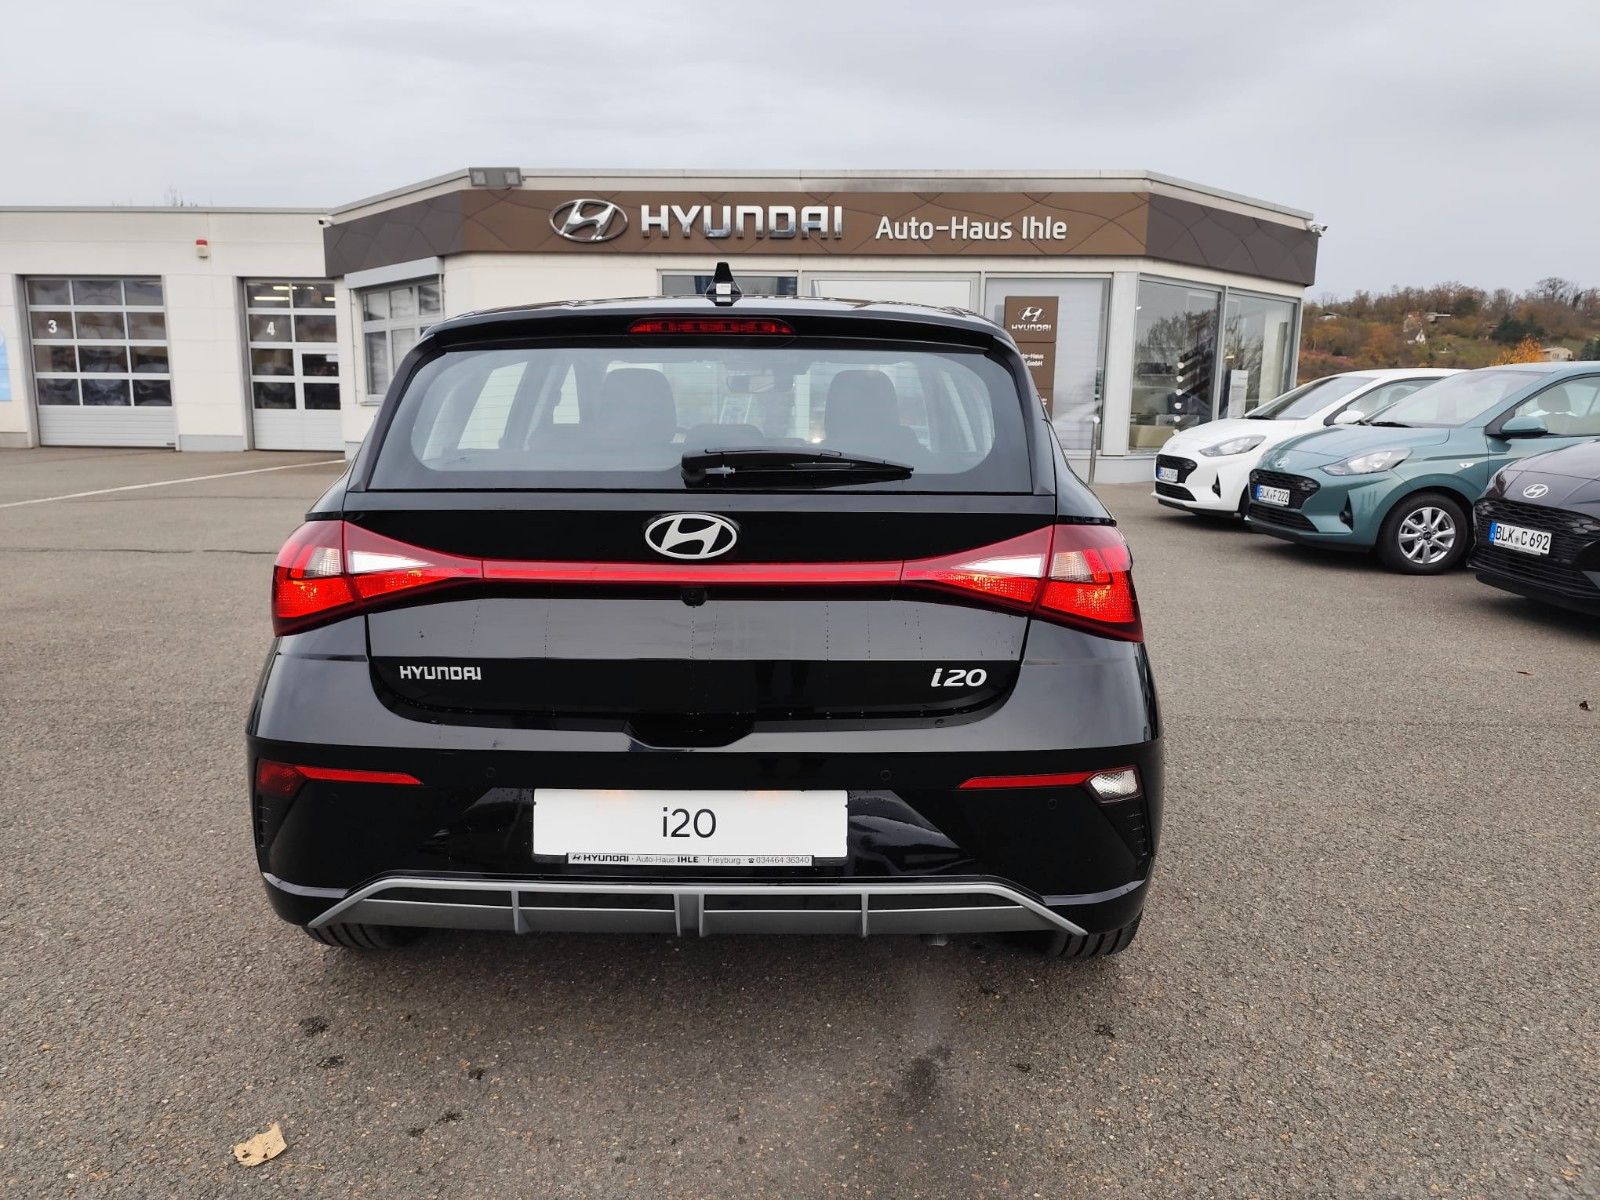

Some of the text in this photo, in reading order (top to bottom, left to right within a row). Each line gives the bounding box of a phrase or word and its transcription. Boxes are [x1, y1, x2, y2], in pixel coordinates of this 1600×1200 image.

[640, 204, 844, 240] HYUNDAI
[875, 215, 1067, 240] Auto-Haus Ihle
[47, 319, 58, 334] 3
[266, 321, 276, 336] 4
[1495, 525, 1515, 543] BLK
[1521, 531, 1528, 545] C
[1529, 533, 1549, 550] 692
[399, 665, 482, 681] HYUNDAI
[930, 667, 987, 687] i20
[662, 806, 717, 838] i20
[583, 854, 629, 863] HYUNDAI
[677, 856, 699, 864] IHLE
[707, 856, 741, 865] Freyburg
